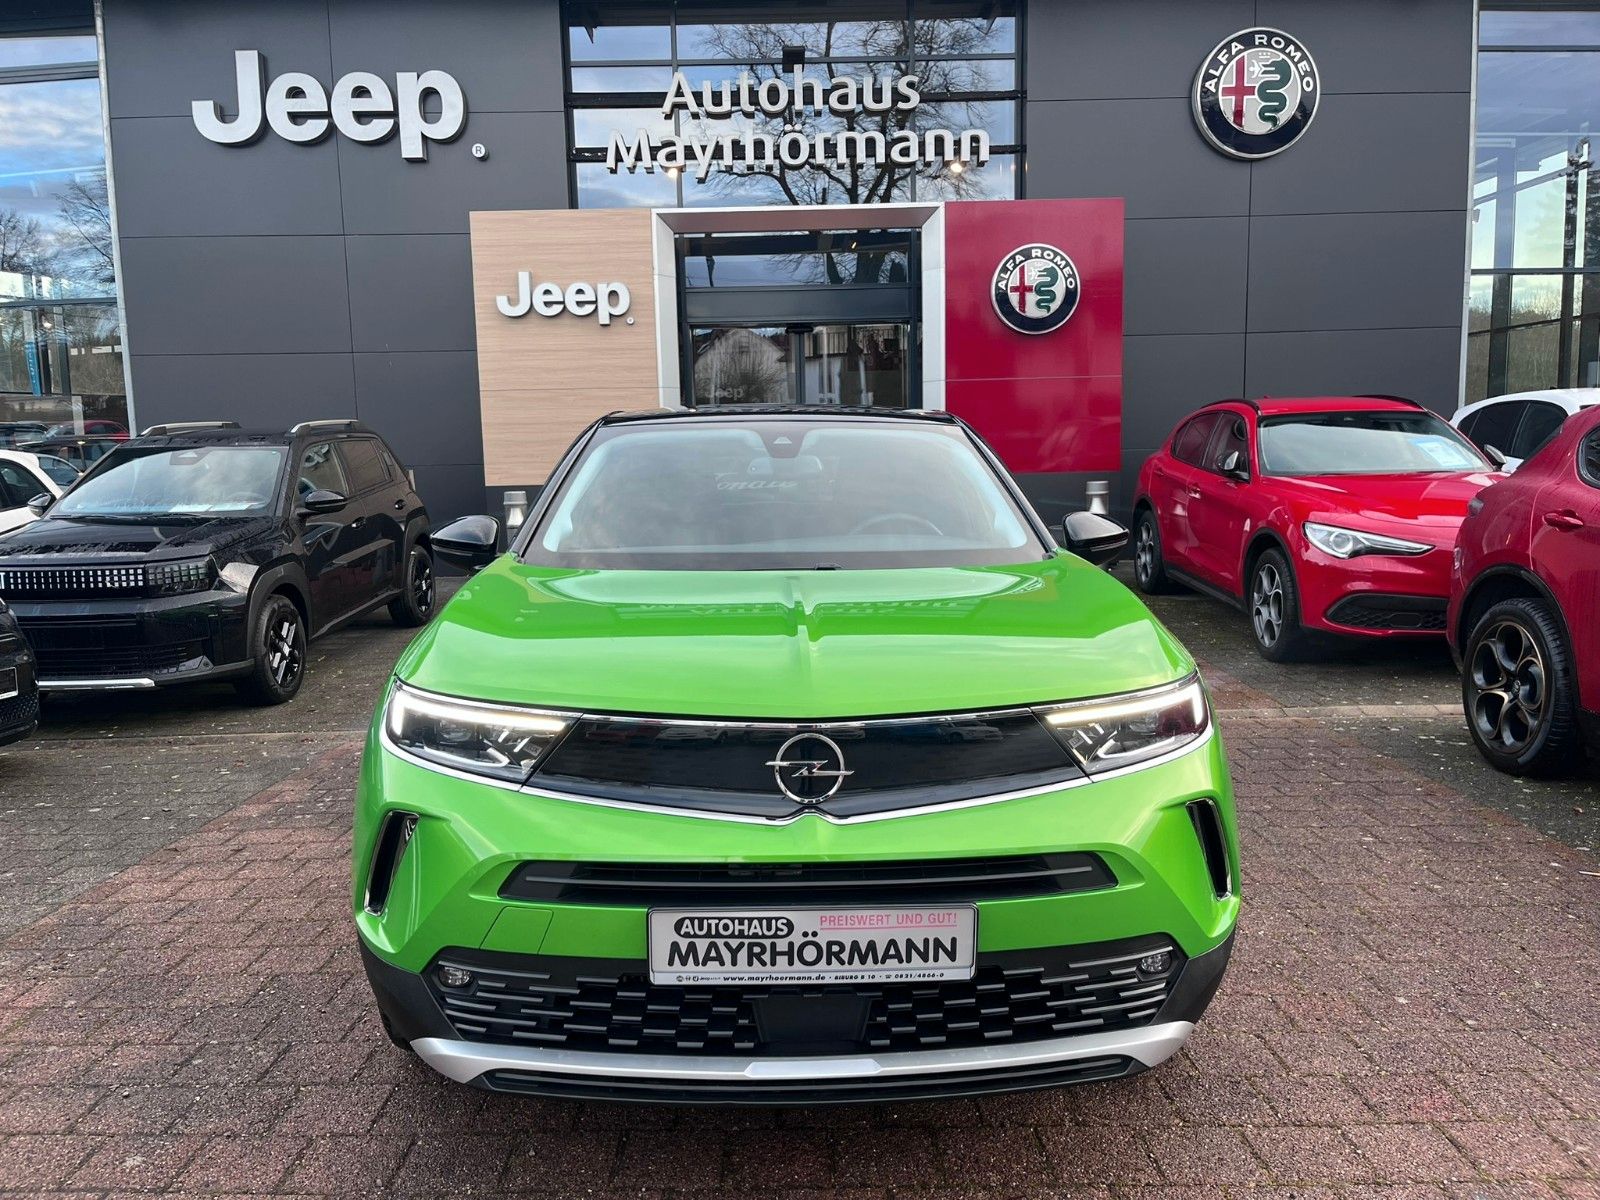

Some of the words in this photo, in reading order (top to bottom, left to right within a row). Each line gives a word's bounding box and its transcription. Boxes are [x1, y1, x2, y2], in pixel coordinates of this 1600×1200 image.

[1204, 41, 1245, 93] ALFA
[1254, 34, 1314, 92] ROMEO
[192, 49, 467, 161] Jeep
[661, 65, 922, 117] Autohaus
[606, 124, 990, 182] Mayrhörmann
[997, 254, 1026, 291] ALFA
[1031, 248, 1076, 289] ROMEO
[496, 271, 631, 325] Jeep
[680, 918, 789, 936] AUTOHAUS
[819, 914, 891, 926] PREISWERT
[897, 914, 923, 925] UND
[928, 912, 957, 924] GUT!
[667, 931, 957, 967] MAYRHÖRMANN
[723, 974, 826, 983] www.mayrhoermann.de
